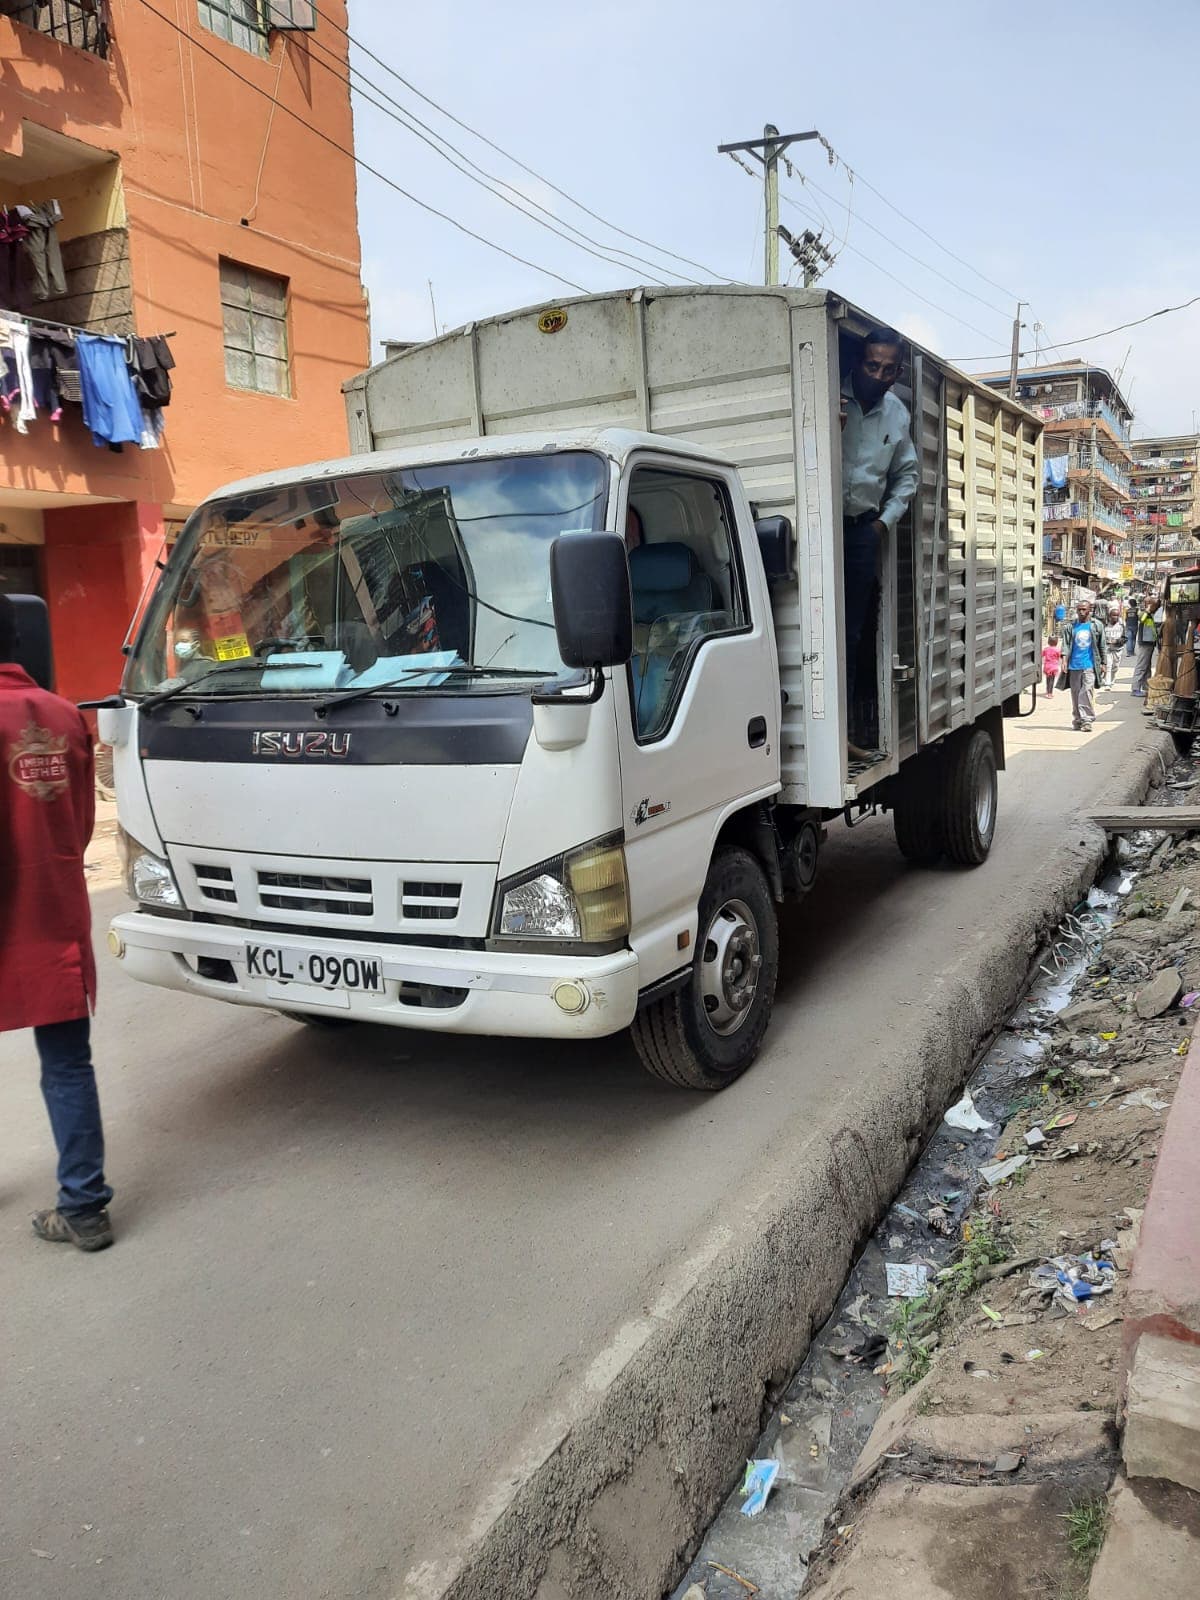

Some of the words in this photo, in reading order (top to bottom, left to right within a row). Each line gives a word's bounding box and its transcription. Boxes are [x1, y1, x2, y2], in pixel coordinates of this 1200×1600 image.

[251, 731, 352, 758] ISUZU
[246, 945, 294, 979] KCL
[308, 954, 379, 990] 090W
